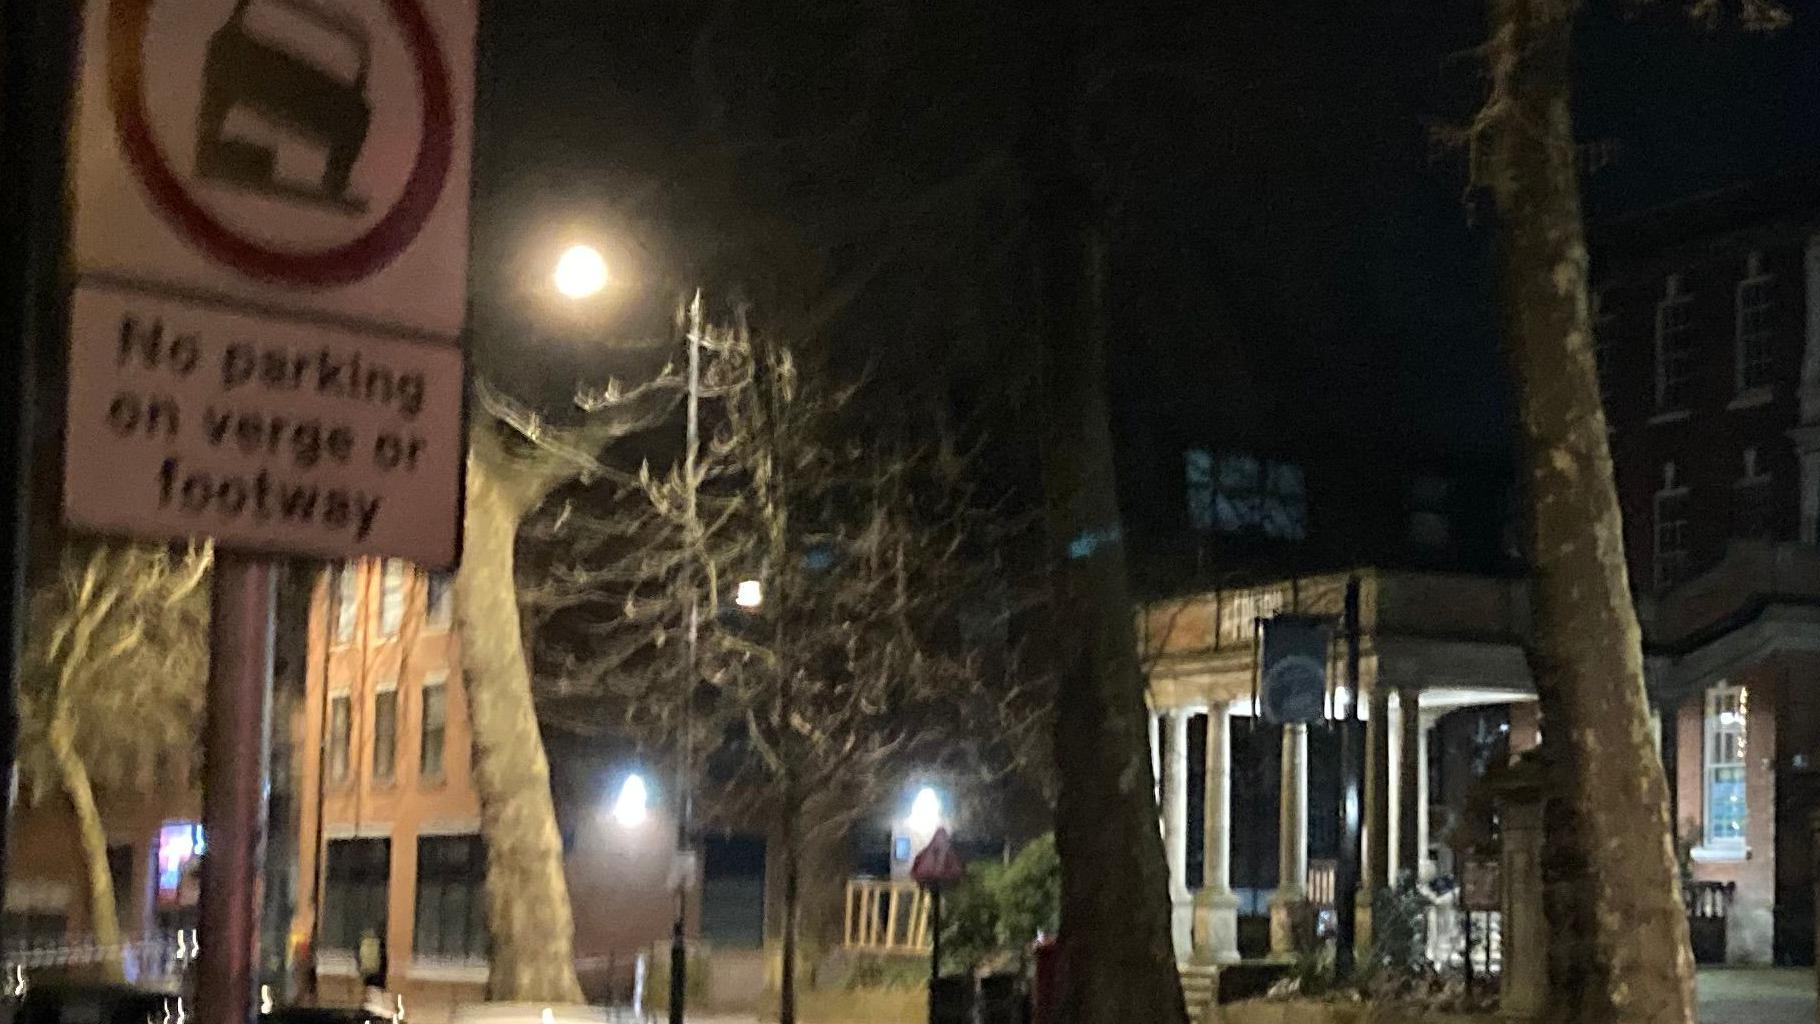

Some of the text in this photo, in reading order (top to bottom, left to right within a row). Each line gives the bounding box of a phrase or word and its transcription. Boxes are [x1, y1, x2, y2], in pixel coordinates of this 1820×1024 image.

[118, 311, 427, 420] No parking
[106, 390, 428, 472] on verge or
[157, 457, 384, 543] footway
